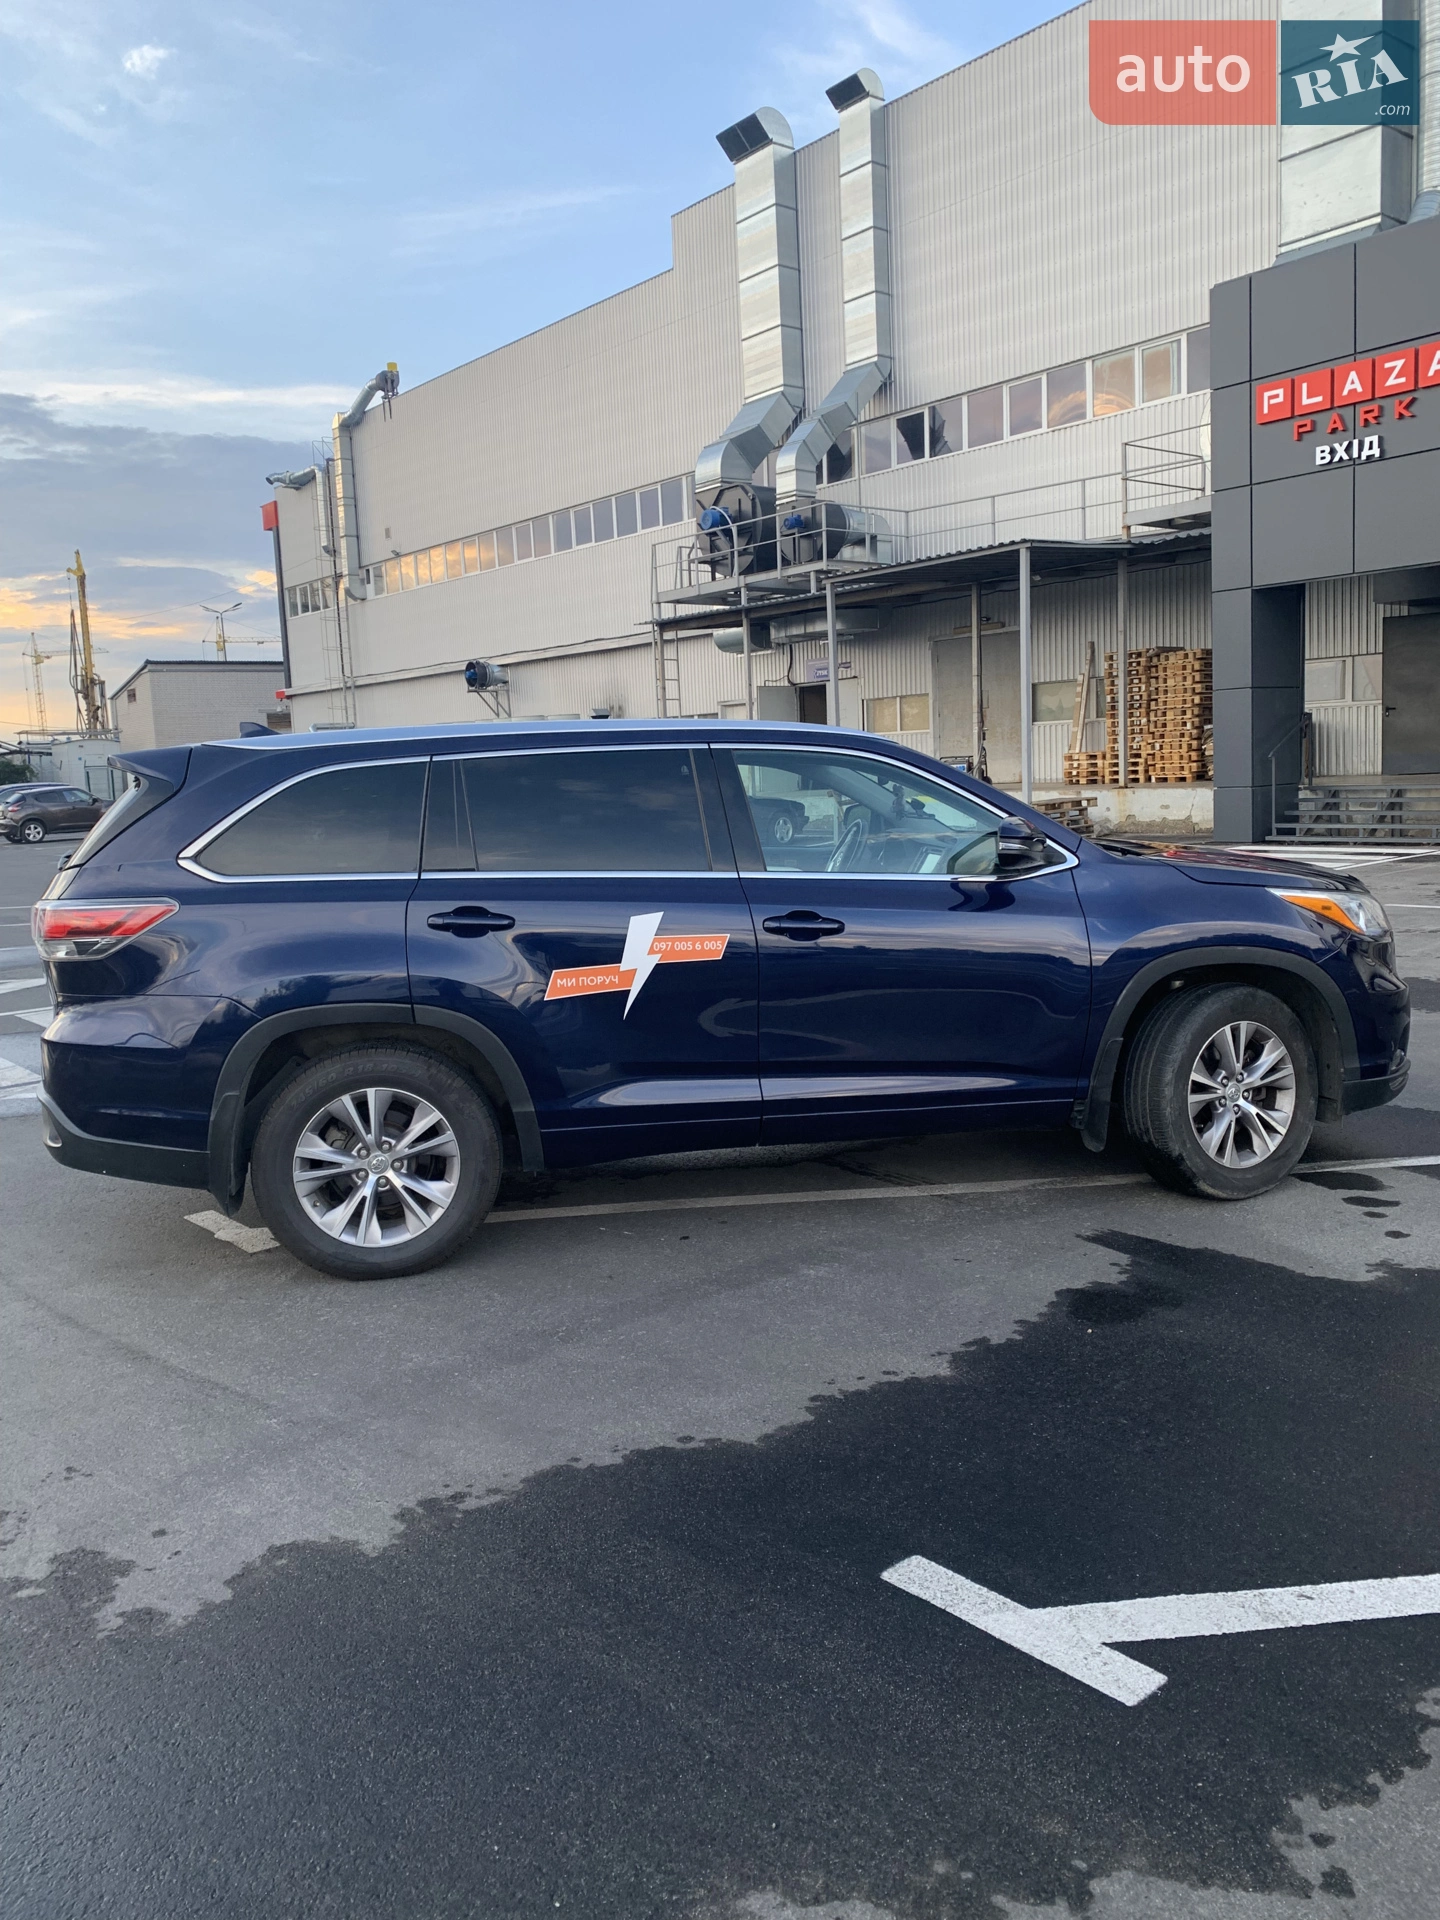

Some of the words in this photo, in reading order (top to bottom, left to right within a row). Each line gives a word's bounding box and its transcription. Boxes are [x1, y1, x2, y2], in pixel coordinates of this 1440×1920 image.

[1263, 350, 1440, 415] PLAZA
[1293, 396, 1416, 441] PARK
[1315, 435, 1381, 466] ВХІД
[653, 942, 671, 952] 097
[674, 941, 693, 951] 005
[695, 941, 701, 951] 6
[704, 940, 722, 950] 005
[556, 977, 576, 988] МИ
[579, 975, 619, 987] ПОРУЧ
